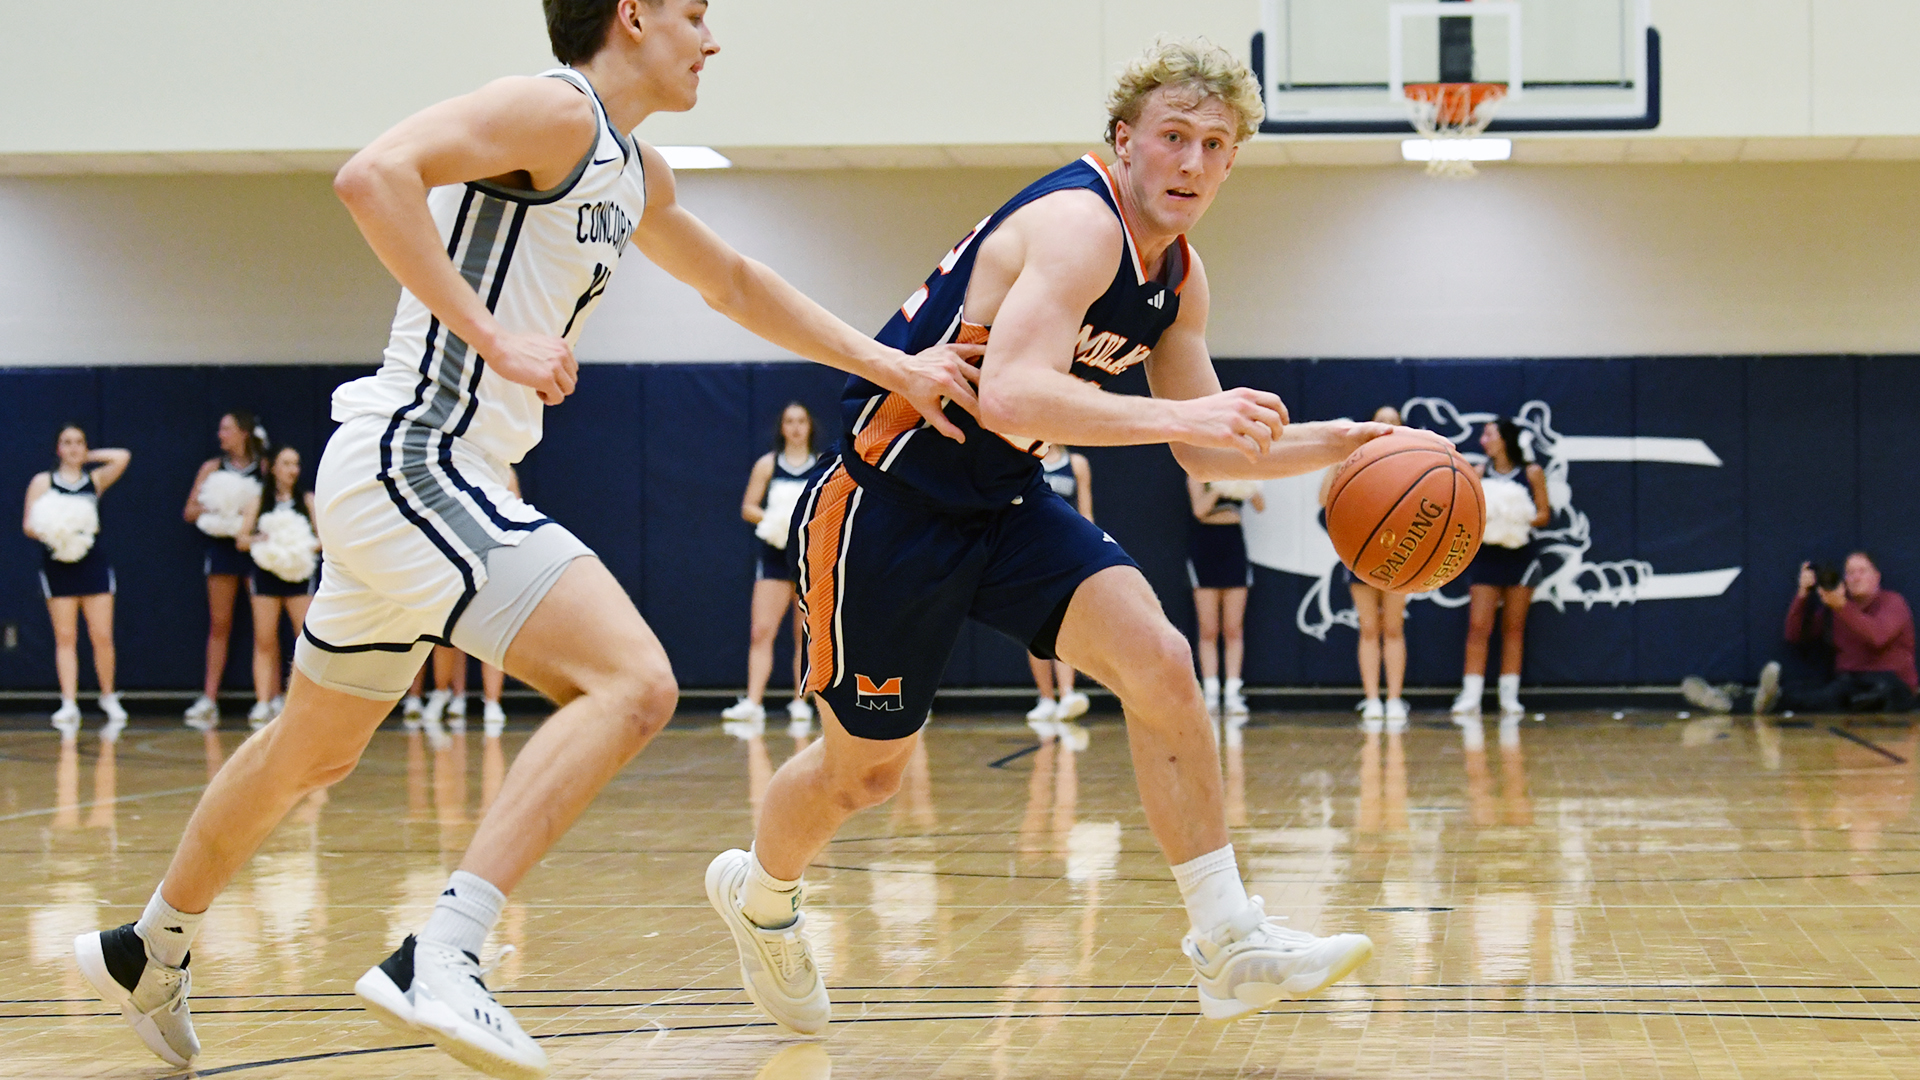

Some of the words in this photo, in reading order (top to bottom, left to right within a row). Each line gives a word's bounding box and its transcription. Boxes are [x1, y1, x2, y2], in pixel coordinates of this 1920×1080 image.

[576, 200, 634, 259] CONCORD
[1369, 497, 1444, 586] SPALDING
[1421, 523, 1466, 588] EGACY
[854, 673, 904, 711] M
